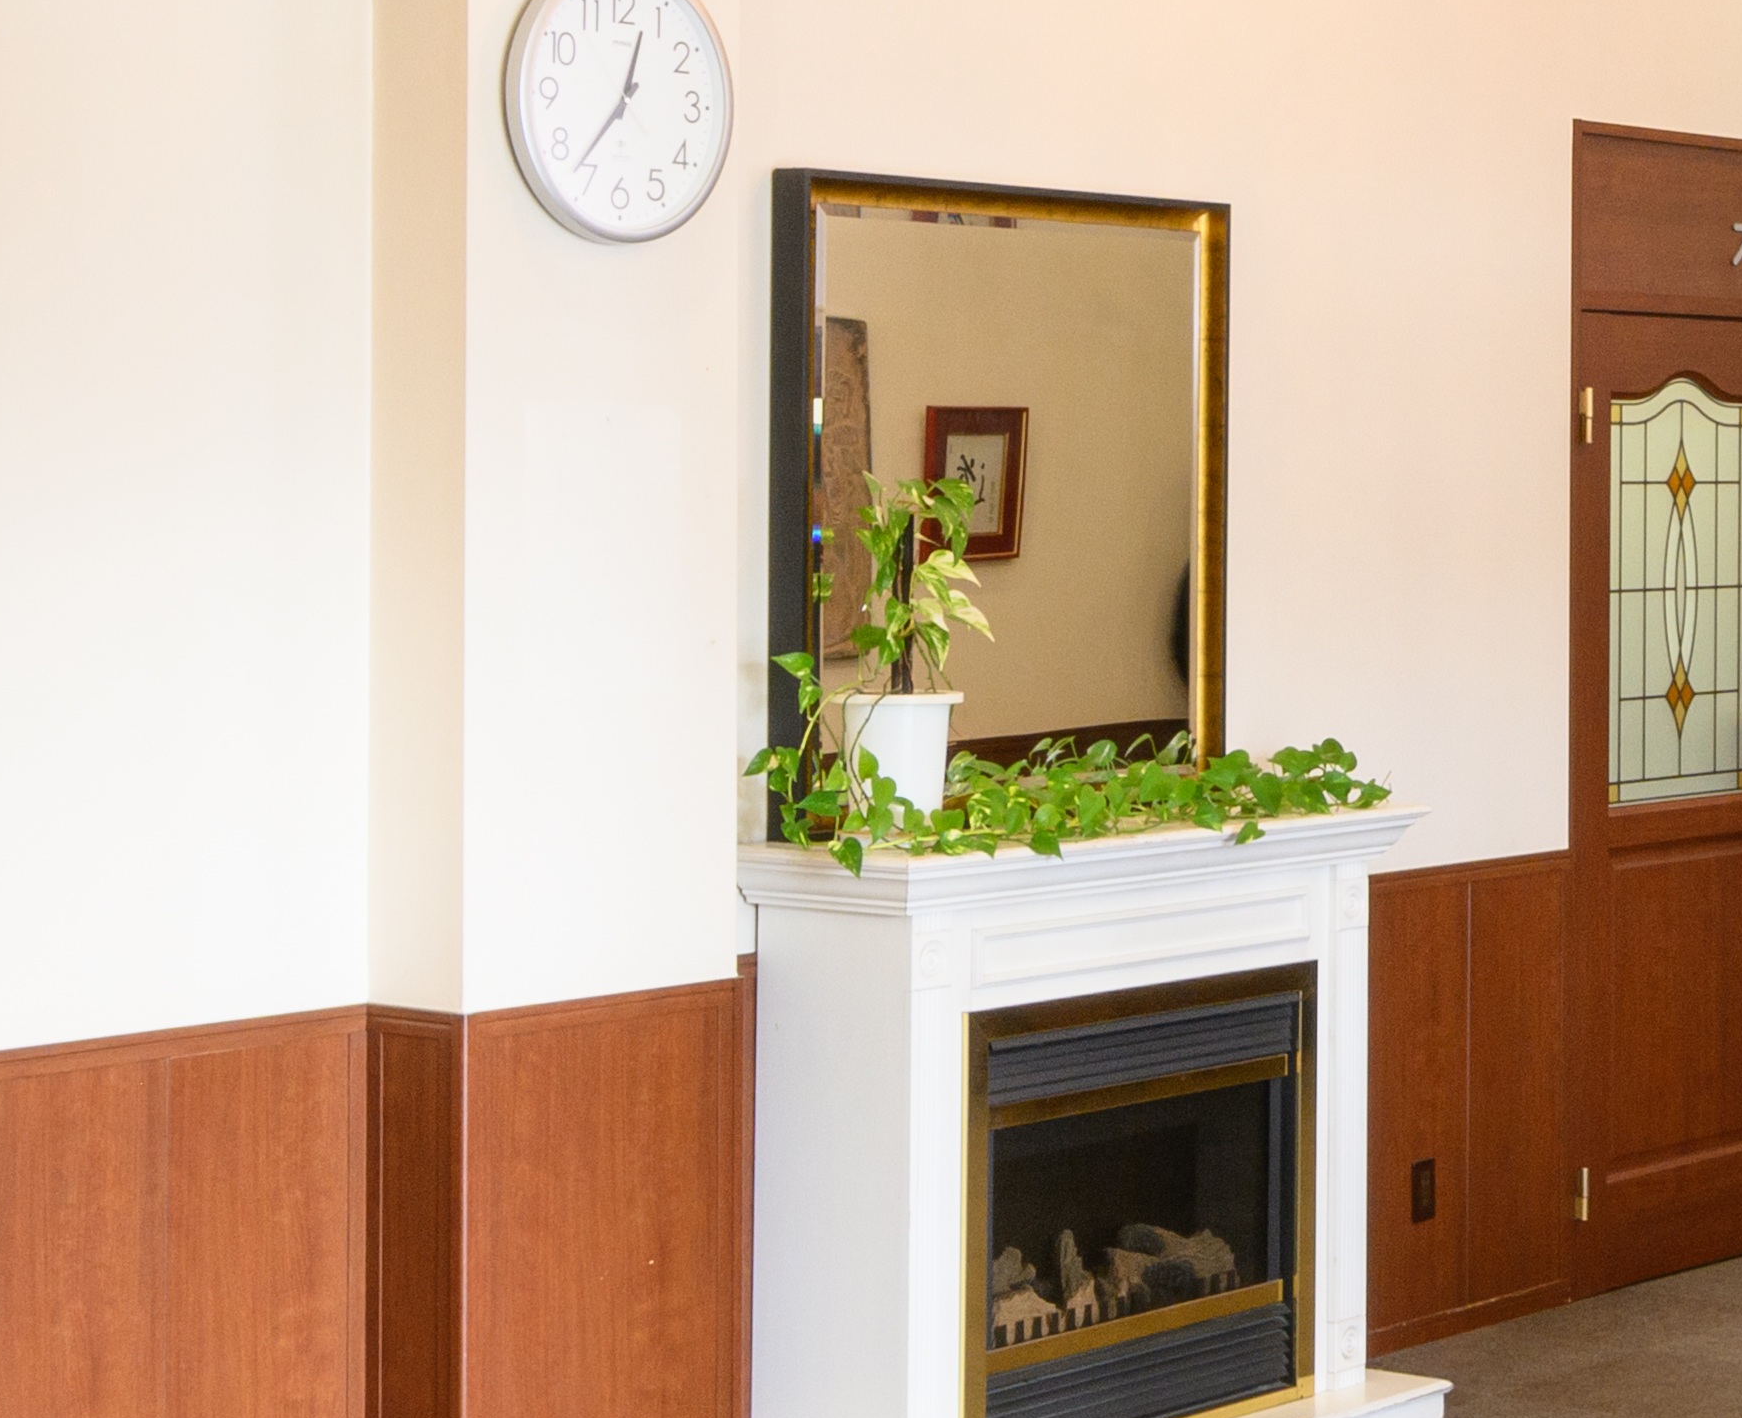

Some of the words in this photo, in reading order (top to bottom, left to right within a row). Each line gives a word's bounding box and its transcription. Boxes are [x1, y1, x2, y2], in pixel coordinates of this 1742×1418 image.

[655, 6, 661, 39] 1
[551, 30, 576, 66] 10
[673, 41, 690, 74] 2
[539, 76, 559, 110] 9
[683, 90, 701, 123] 3
[551, 127, 570, 161] 8
[672, 139, 690, 170] 4
[580, 163, 598, 197] 7
[610, 176, 630, 210] 6
[646, 168, 665, 202] 5
